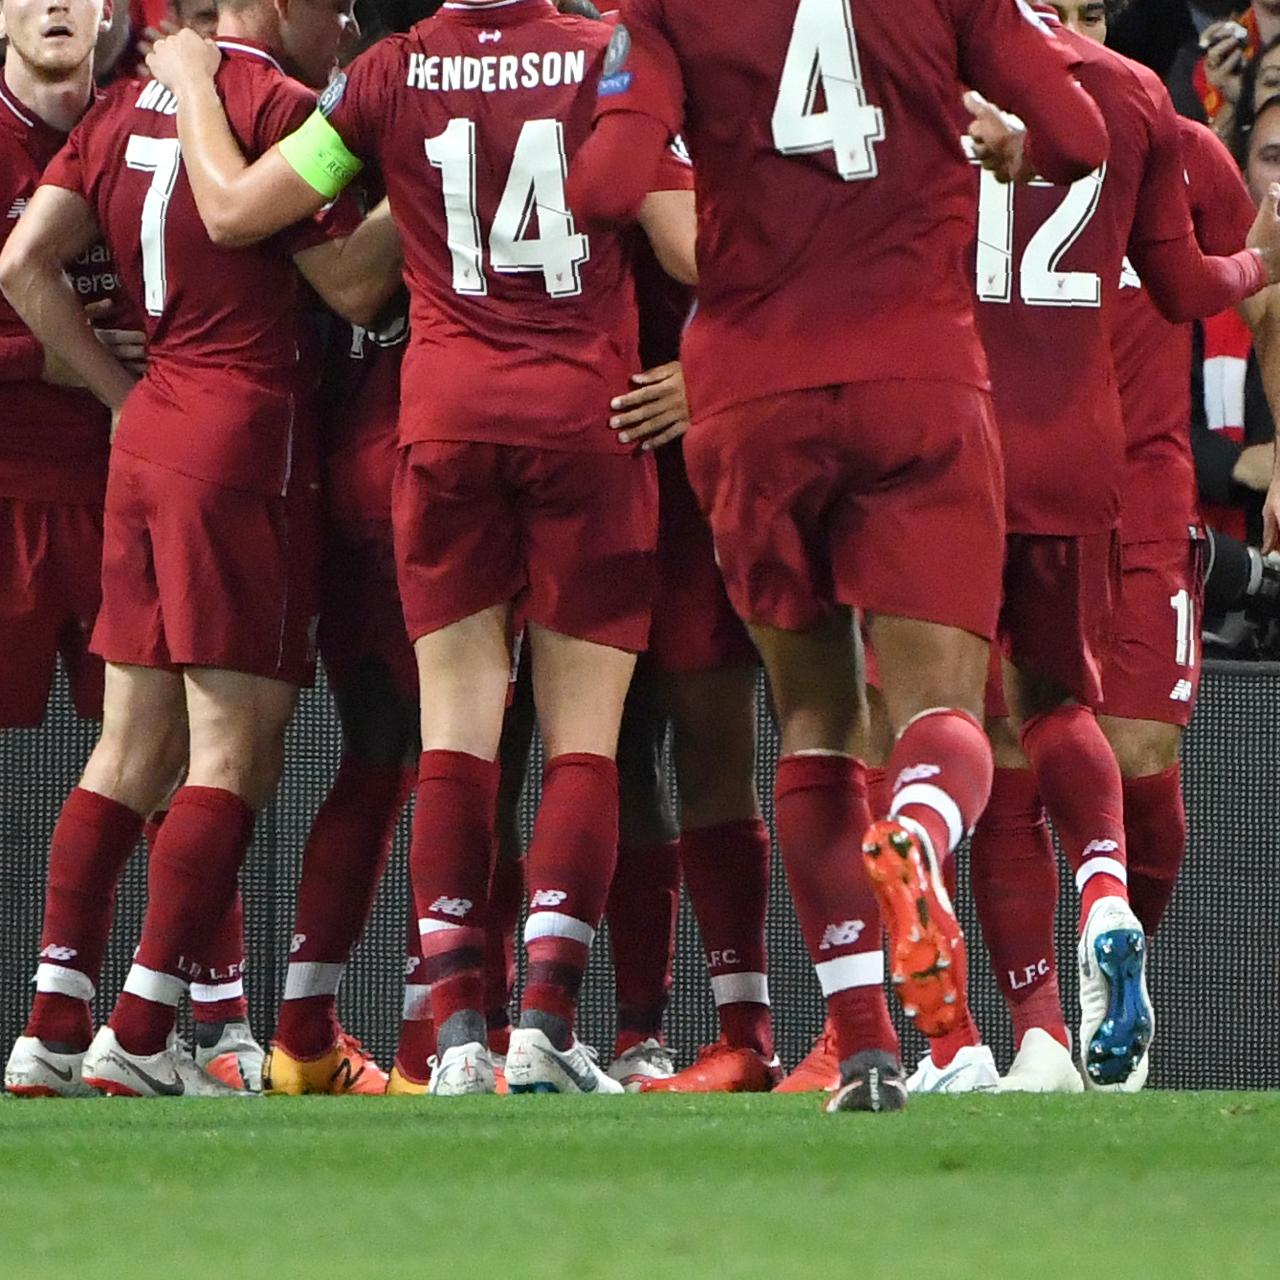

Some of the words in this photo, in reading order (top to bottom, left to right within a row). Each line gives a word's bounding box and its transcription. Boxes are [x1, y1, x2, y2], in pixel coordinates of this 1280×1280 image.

[406, 50, 586, 92] HENDERSON
[125, 134, 182, 317] 7
[424, 117, 590, 300] 14
